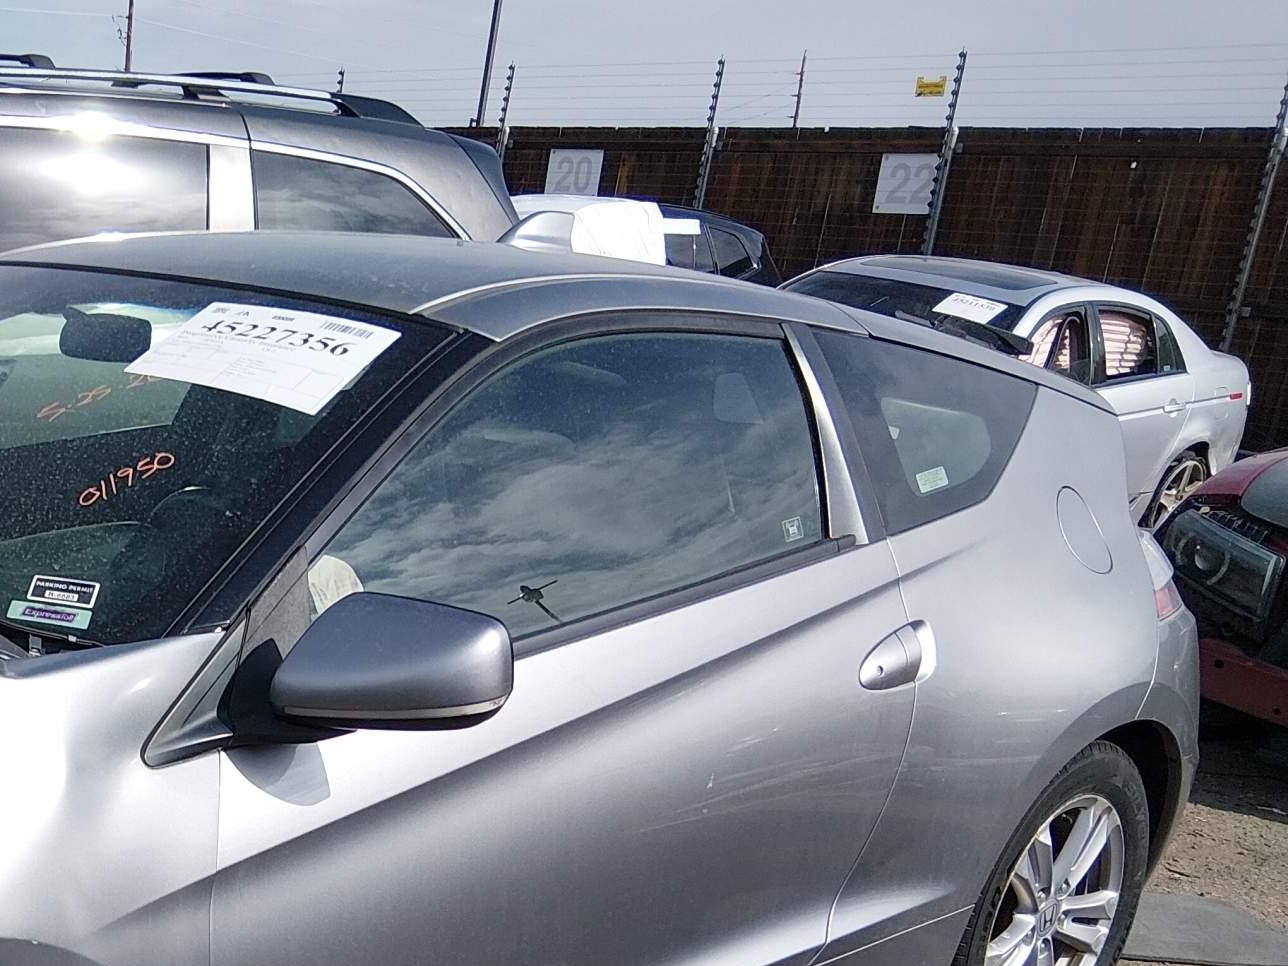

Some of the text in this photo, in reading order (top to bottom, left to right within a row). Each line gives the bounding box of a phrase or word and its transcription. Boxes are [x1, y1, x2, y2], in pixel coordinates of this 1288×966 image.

[554, 157, 593, 193] 20
[885, 162, 934, 204] 22
[201, 319, 353, 357] 45227356
[78, 452, 175, 506] 011950
